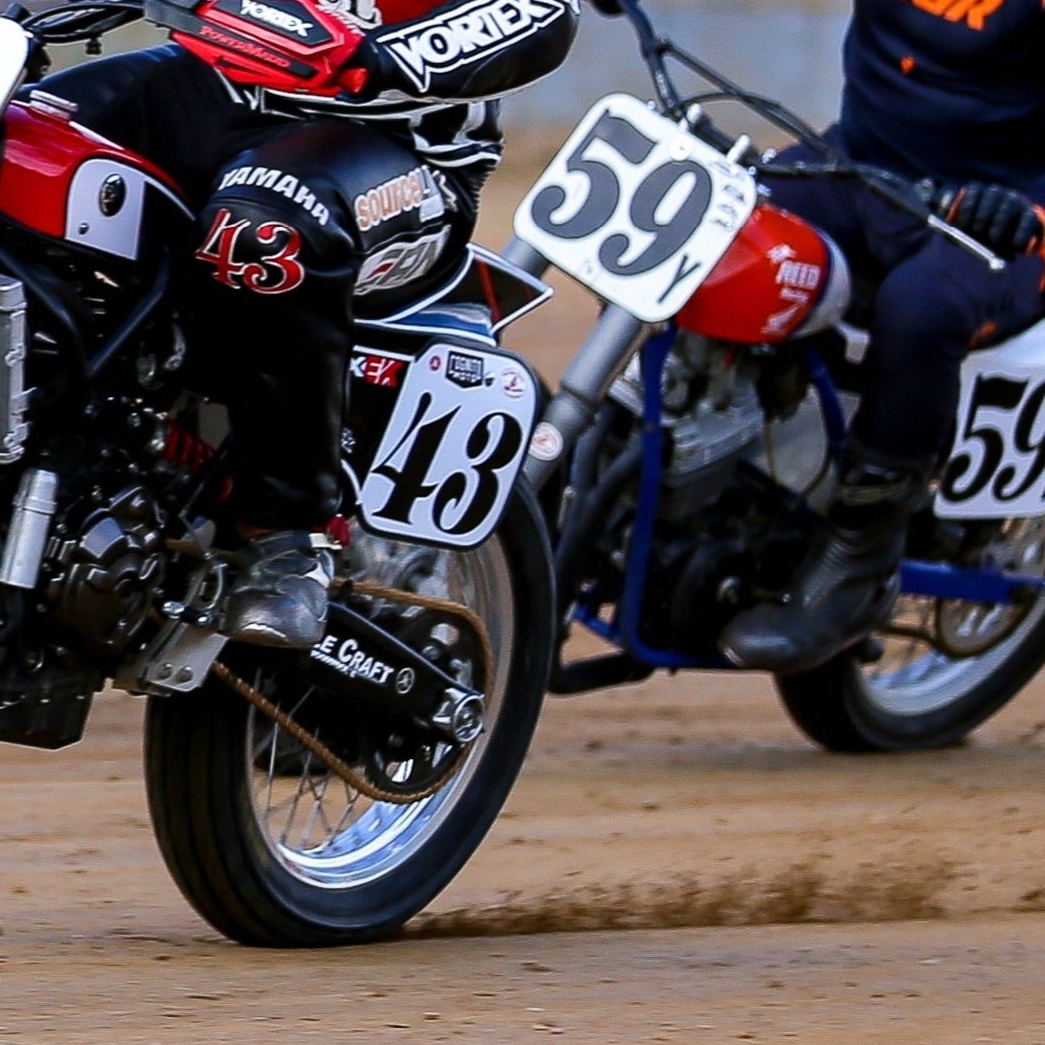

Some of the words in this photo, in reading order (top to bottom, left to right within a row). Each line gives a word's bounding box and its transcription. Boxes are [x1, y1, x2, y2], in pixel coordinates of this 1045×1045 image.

[217, 165, 331, 226] YAMAHA
[194, 207, 306, 295] 43
[370, 391, 524, 536] 43
